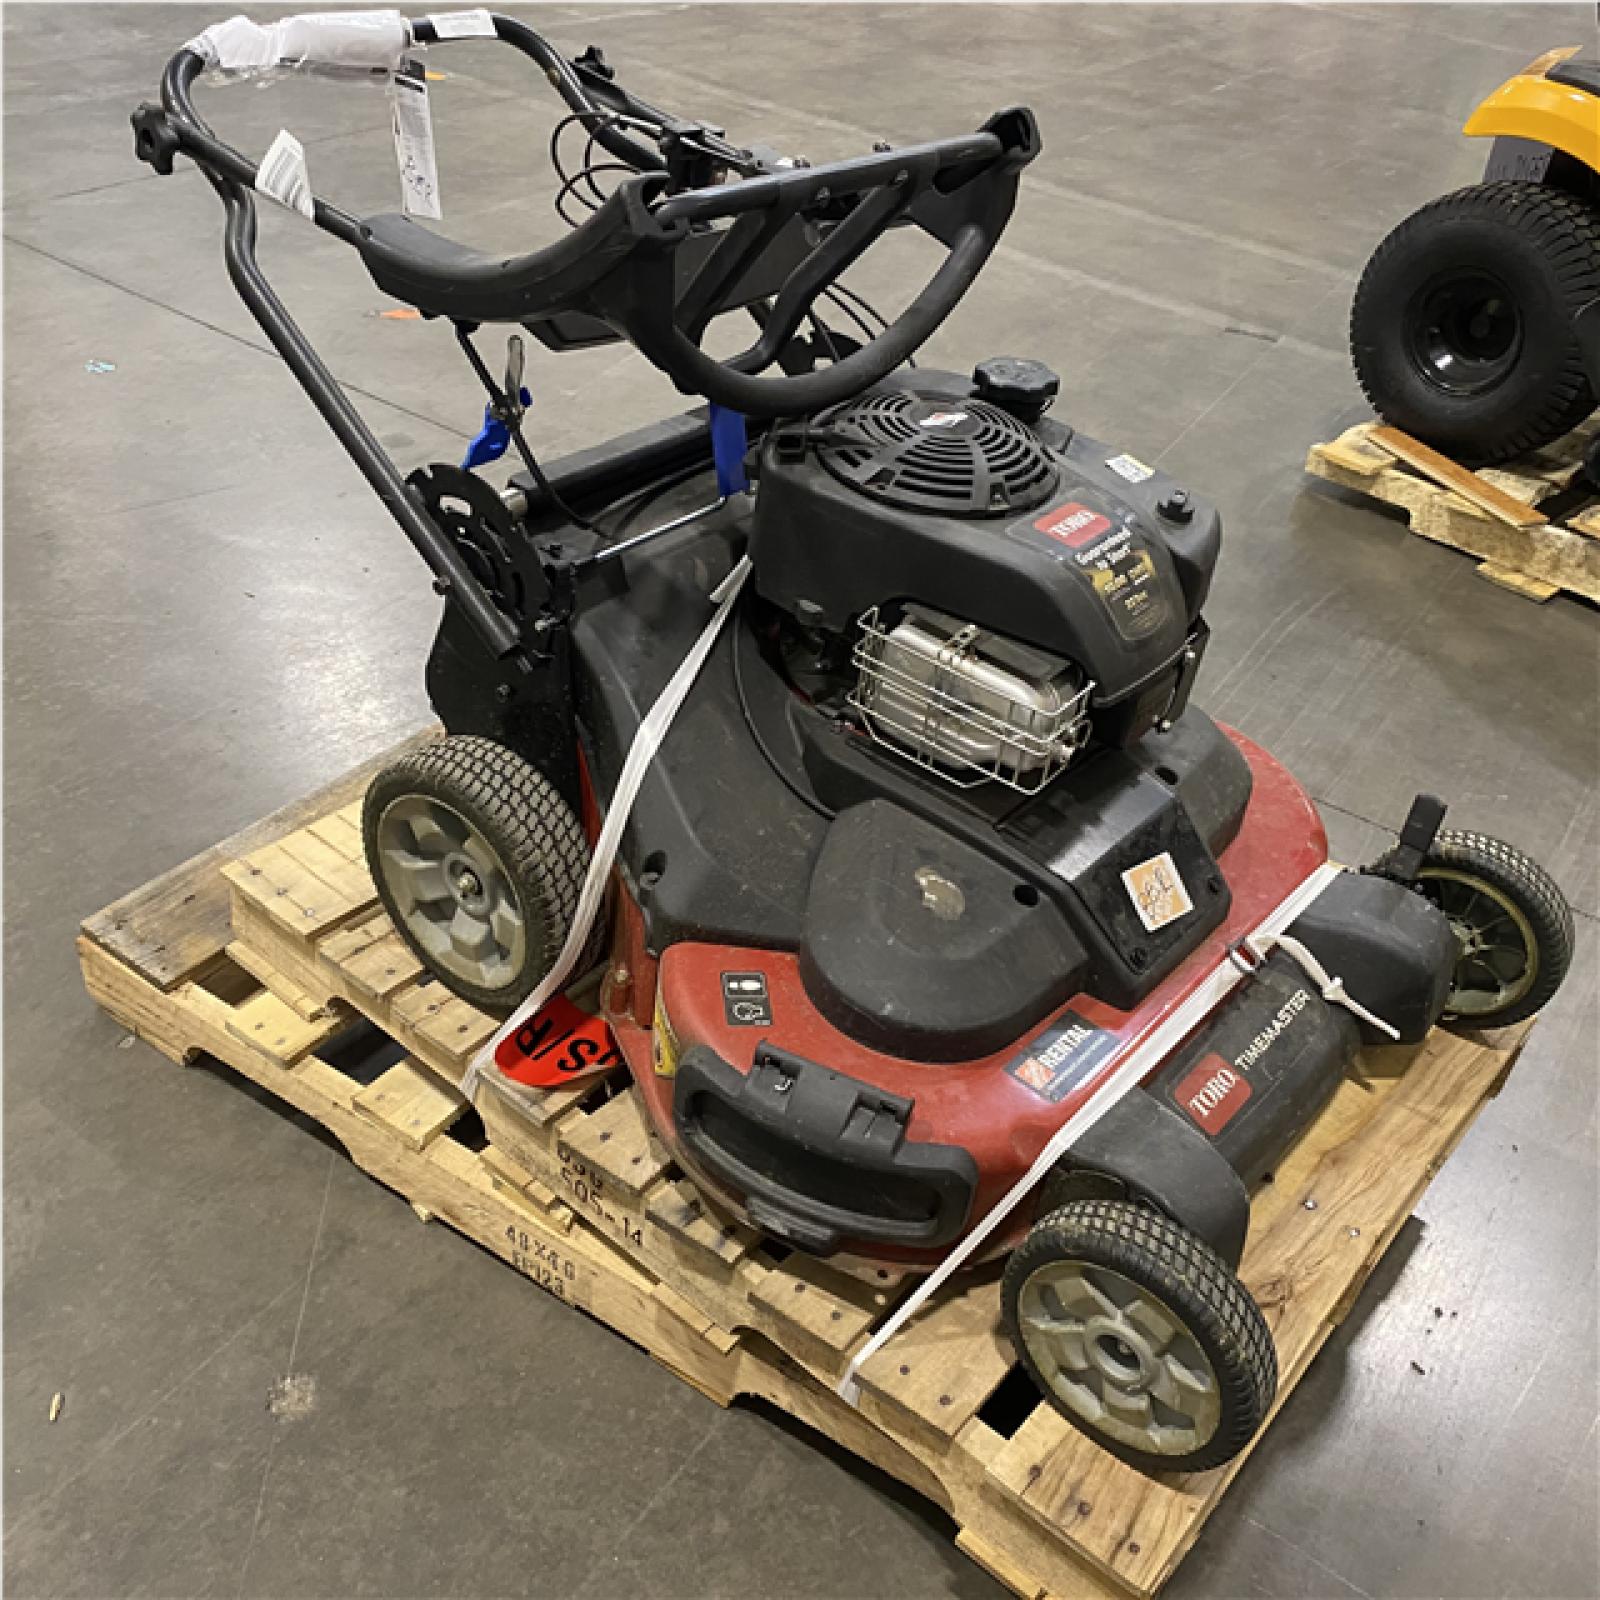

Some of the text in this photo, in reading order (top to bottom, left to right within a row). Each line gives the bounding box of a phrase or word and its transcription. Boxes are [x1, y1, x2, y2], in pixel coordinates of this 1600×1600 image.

[1037, 1024, 1094, 1069] RENTAL
[1189, 989, 1311, 1118] TORO TIMEMASTER
